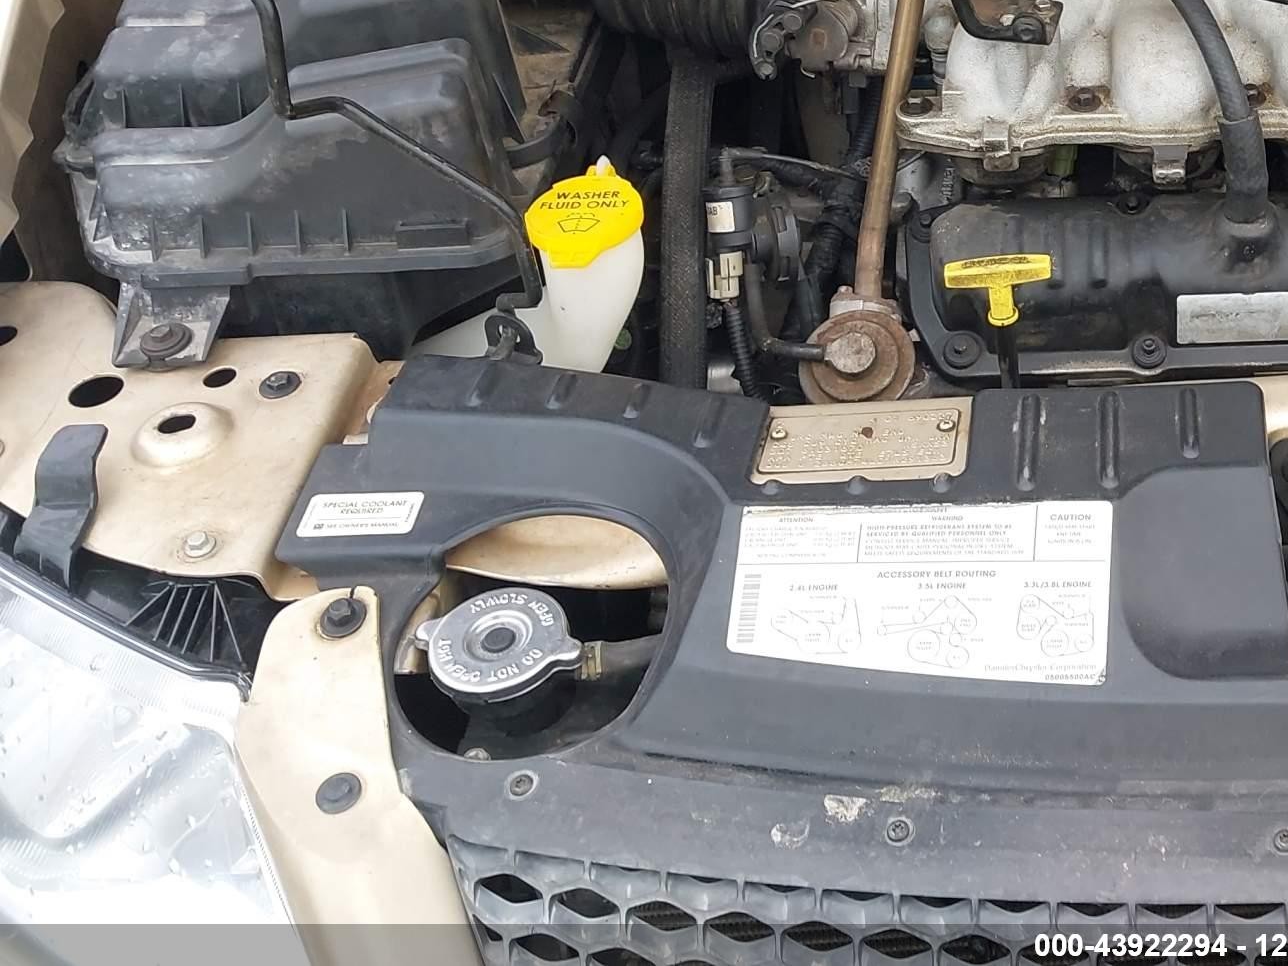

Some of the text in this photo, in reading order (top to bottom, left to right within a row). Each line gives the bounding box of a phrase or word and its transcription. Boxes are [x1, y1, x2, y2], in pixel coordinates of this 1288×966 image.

[556, 190, 621, 200] WASHER
[540, 200, 630, 210] FLUID ONLY
[323, 500, 358, 508] SPECIAL
[470, 593, 554, 627] OPEN SLOWLY
[522, 648, 543, 665] DO
[488, 664, 520, 682] NOT
